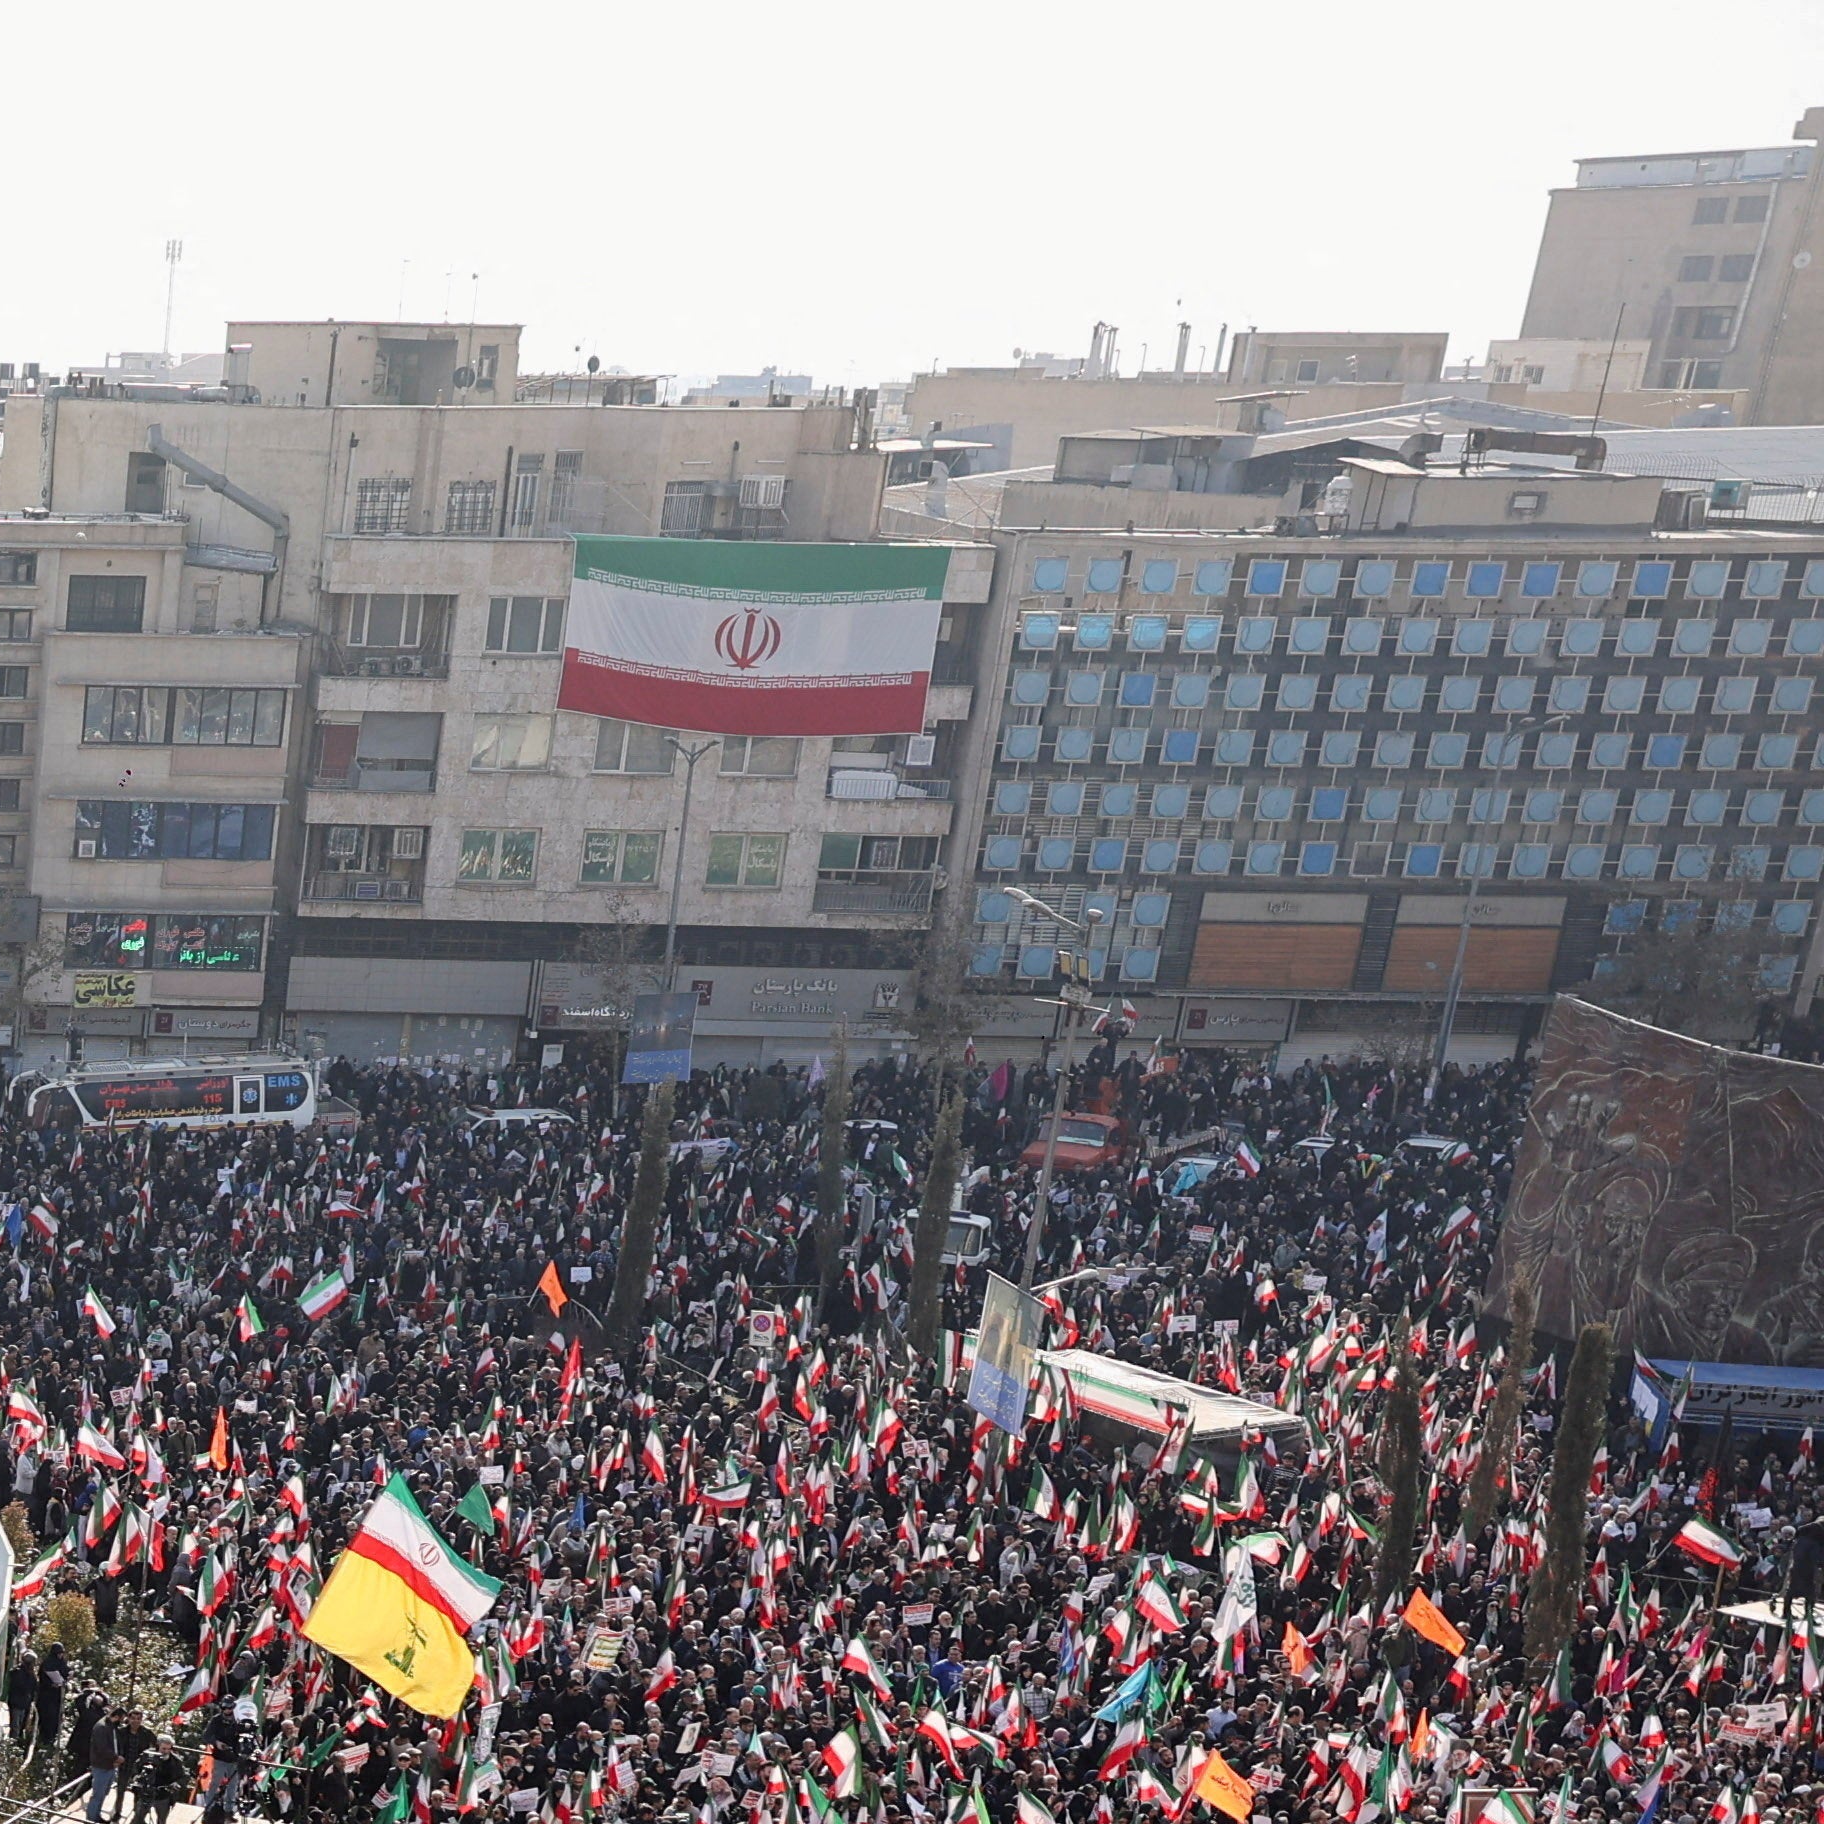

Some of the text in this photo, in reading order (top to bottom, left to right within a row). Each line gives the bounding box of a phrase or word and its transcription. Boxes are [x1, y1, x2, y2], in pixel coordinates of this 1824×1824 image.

[75, 975, 136, 1004] عکاسی
[806, 978, 838, 994] بانک
[752, 1001, 832, 1014] Parsian Bank
[178, 1017, 219, 1031] دوستان
[268, 1075, 301, 1088] EMS
